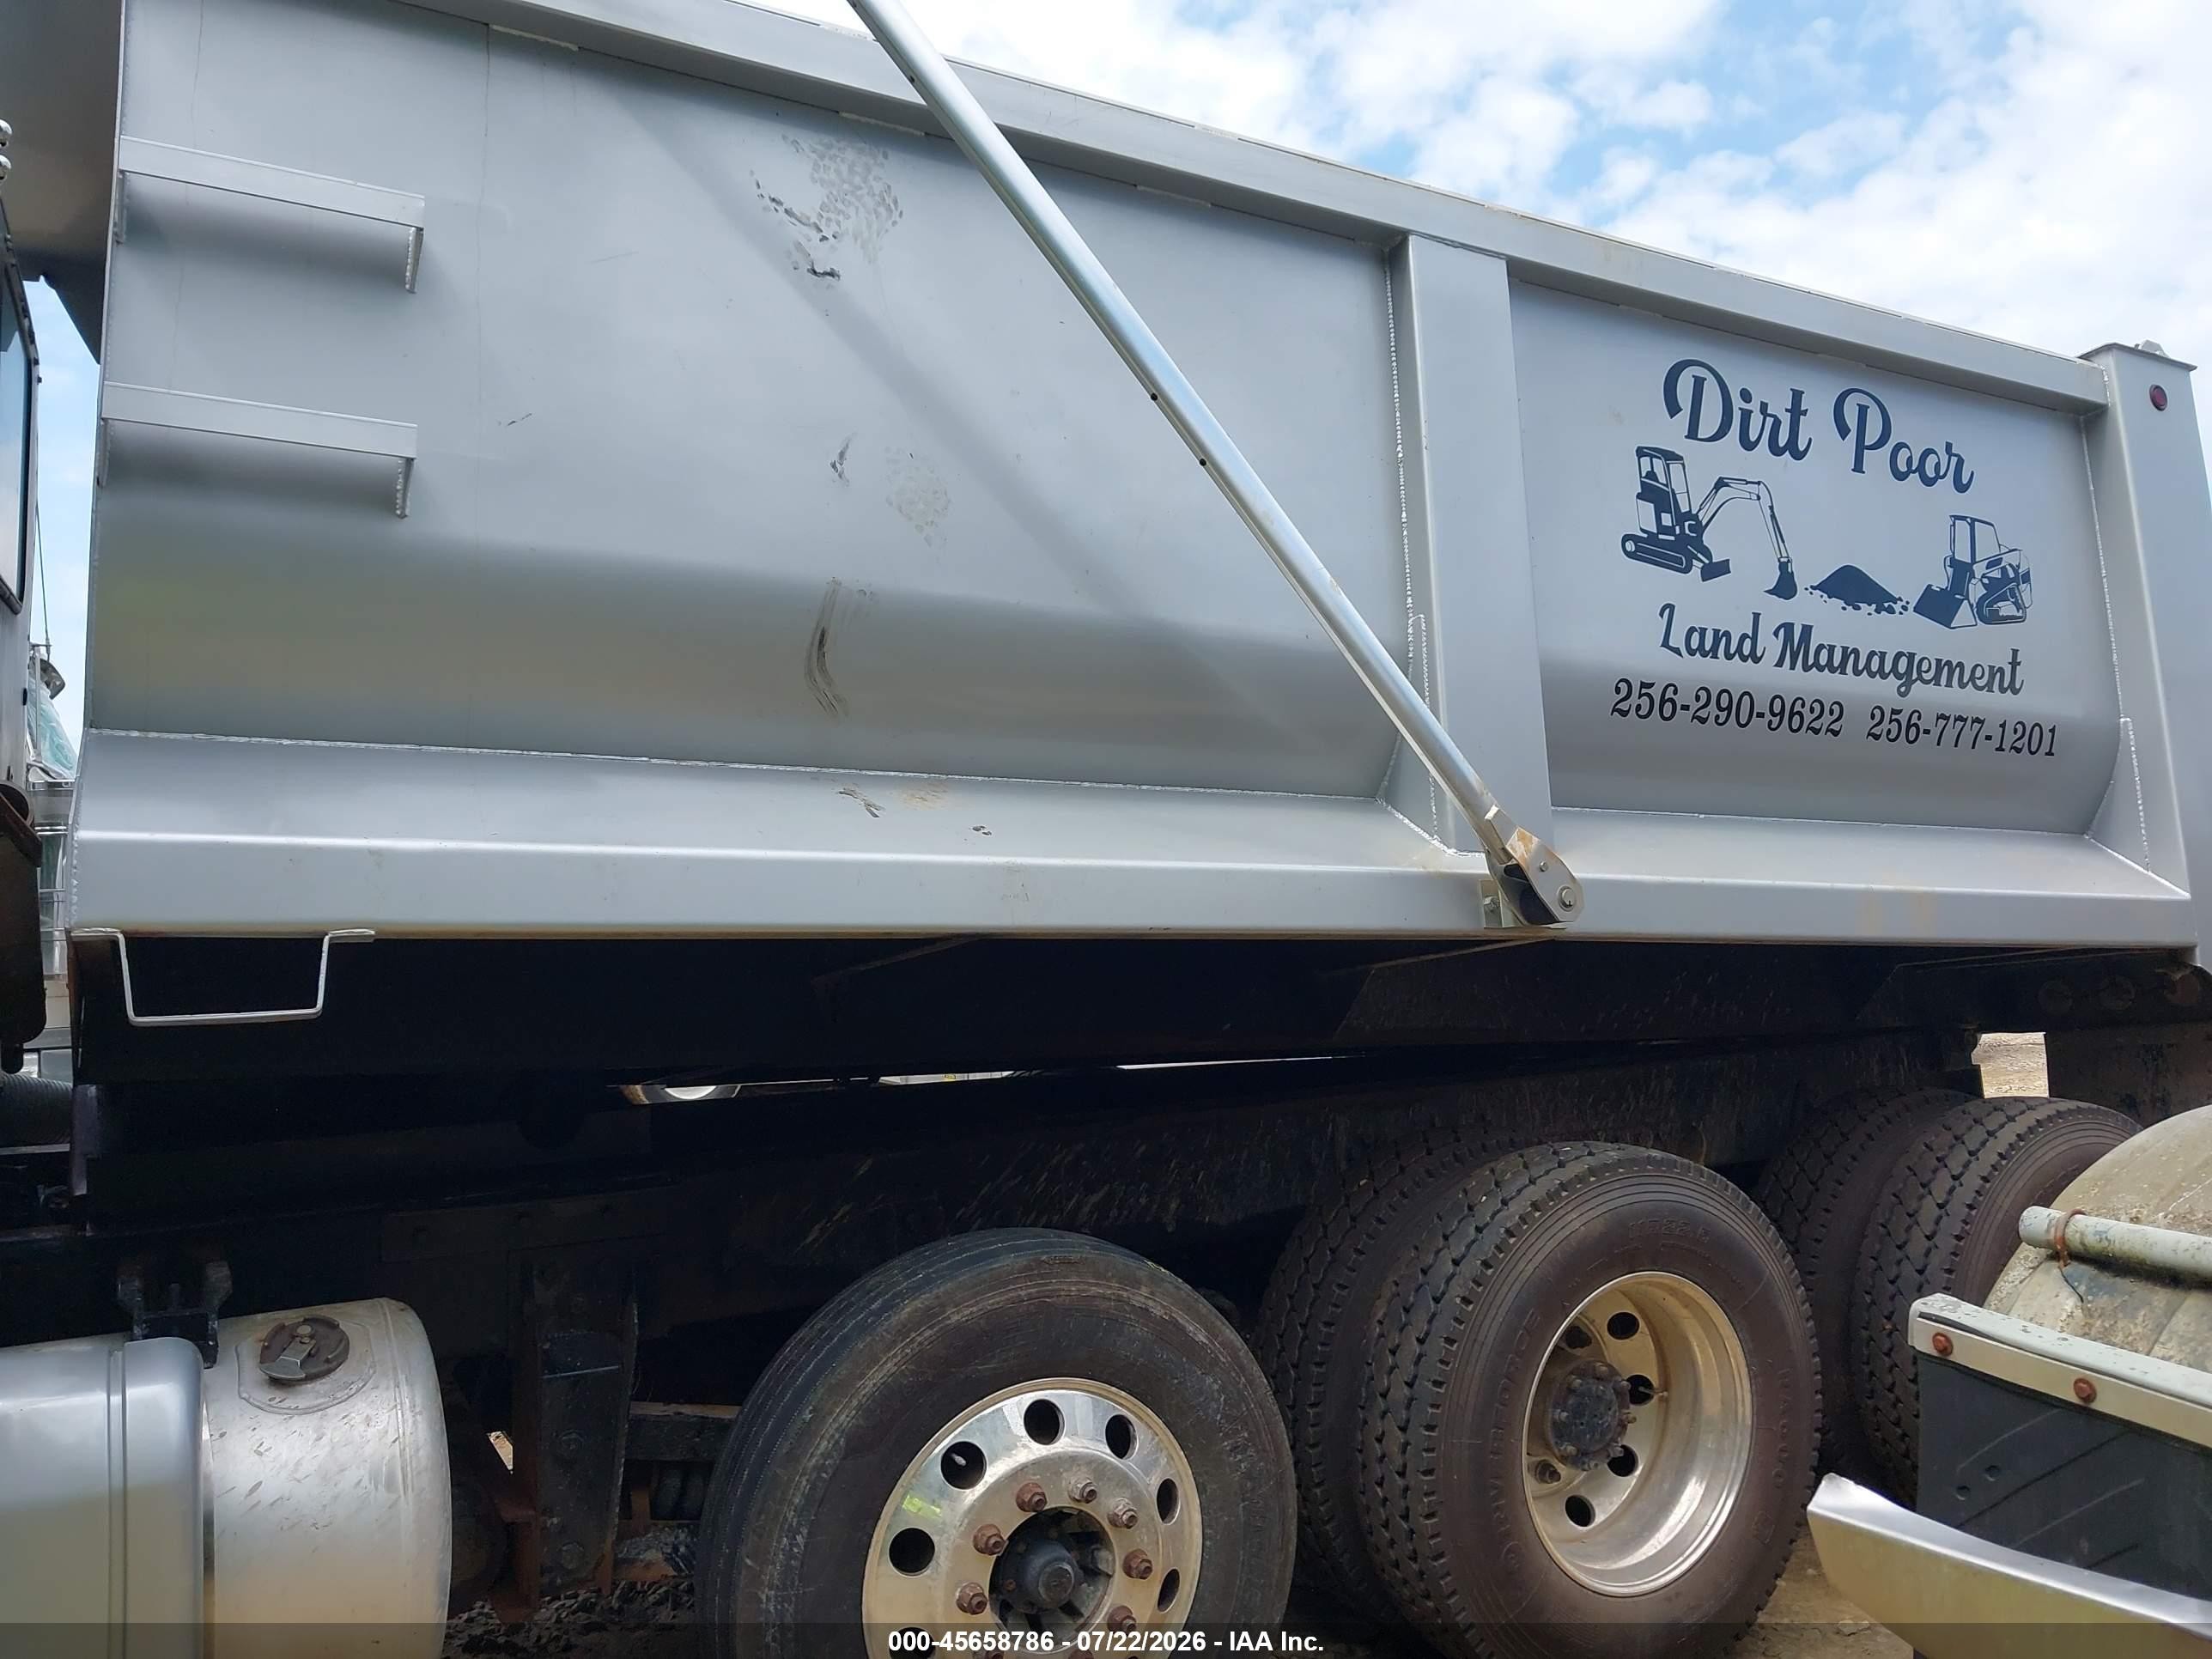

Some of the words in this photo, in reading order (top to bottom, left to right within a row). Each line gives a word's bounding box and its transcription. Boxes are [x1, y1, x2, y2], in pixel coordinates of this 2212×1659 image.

[1662, 358, 1812, 461] Dirt
[1832, 386, 1975, 494] Poor
[1658, 602, 1765, 664] Land
[1772, 621, 2025, 698] Management
[1610, 677, 1845, 738] 256-290-9622
[1866, 704, 2058, 757] 256-777-1201
